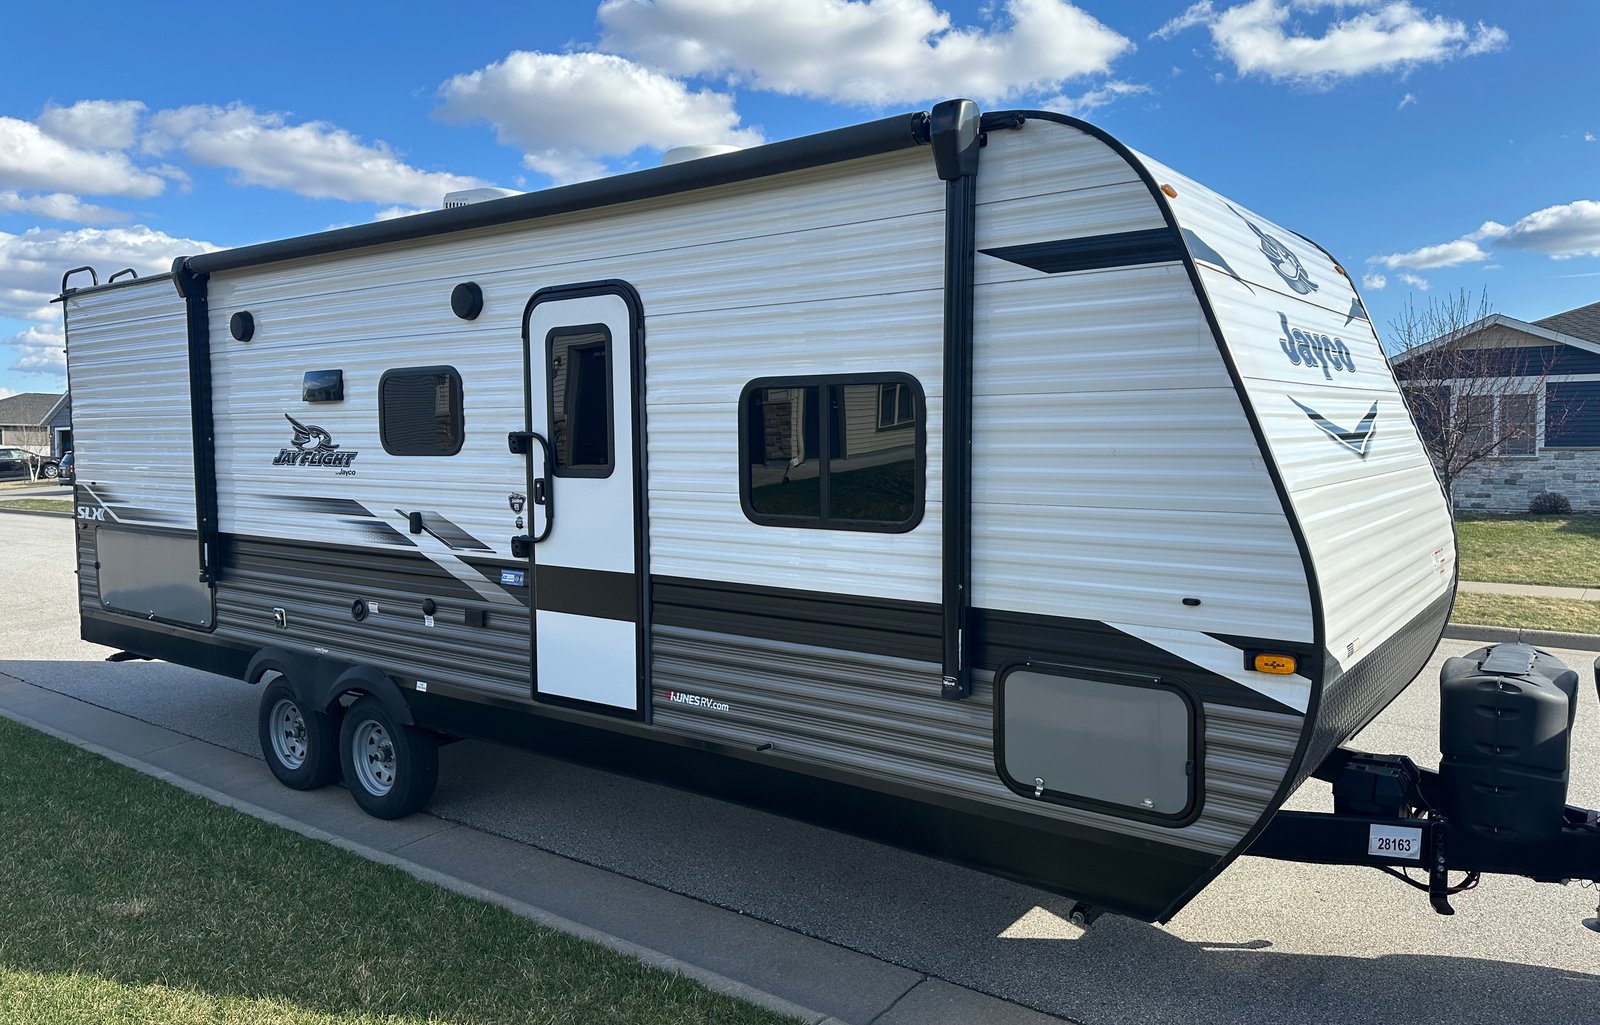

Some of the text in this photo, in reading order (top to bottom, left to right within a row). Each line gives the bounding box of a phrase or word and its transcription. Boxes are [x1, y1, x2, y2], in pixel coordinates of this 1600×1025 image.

[1277, 311, 1356, 381] Jayco
[272, 448, 358, 468] JAY FLIGHT
[77, 506, 105, 521] SLX
[1377, 837, 1411, 852] 28163
